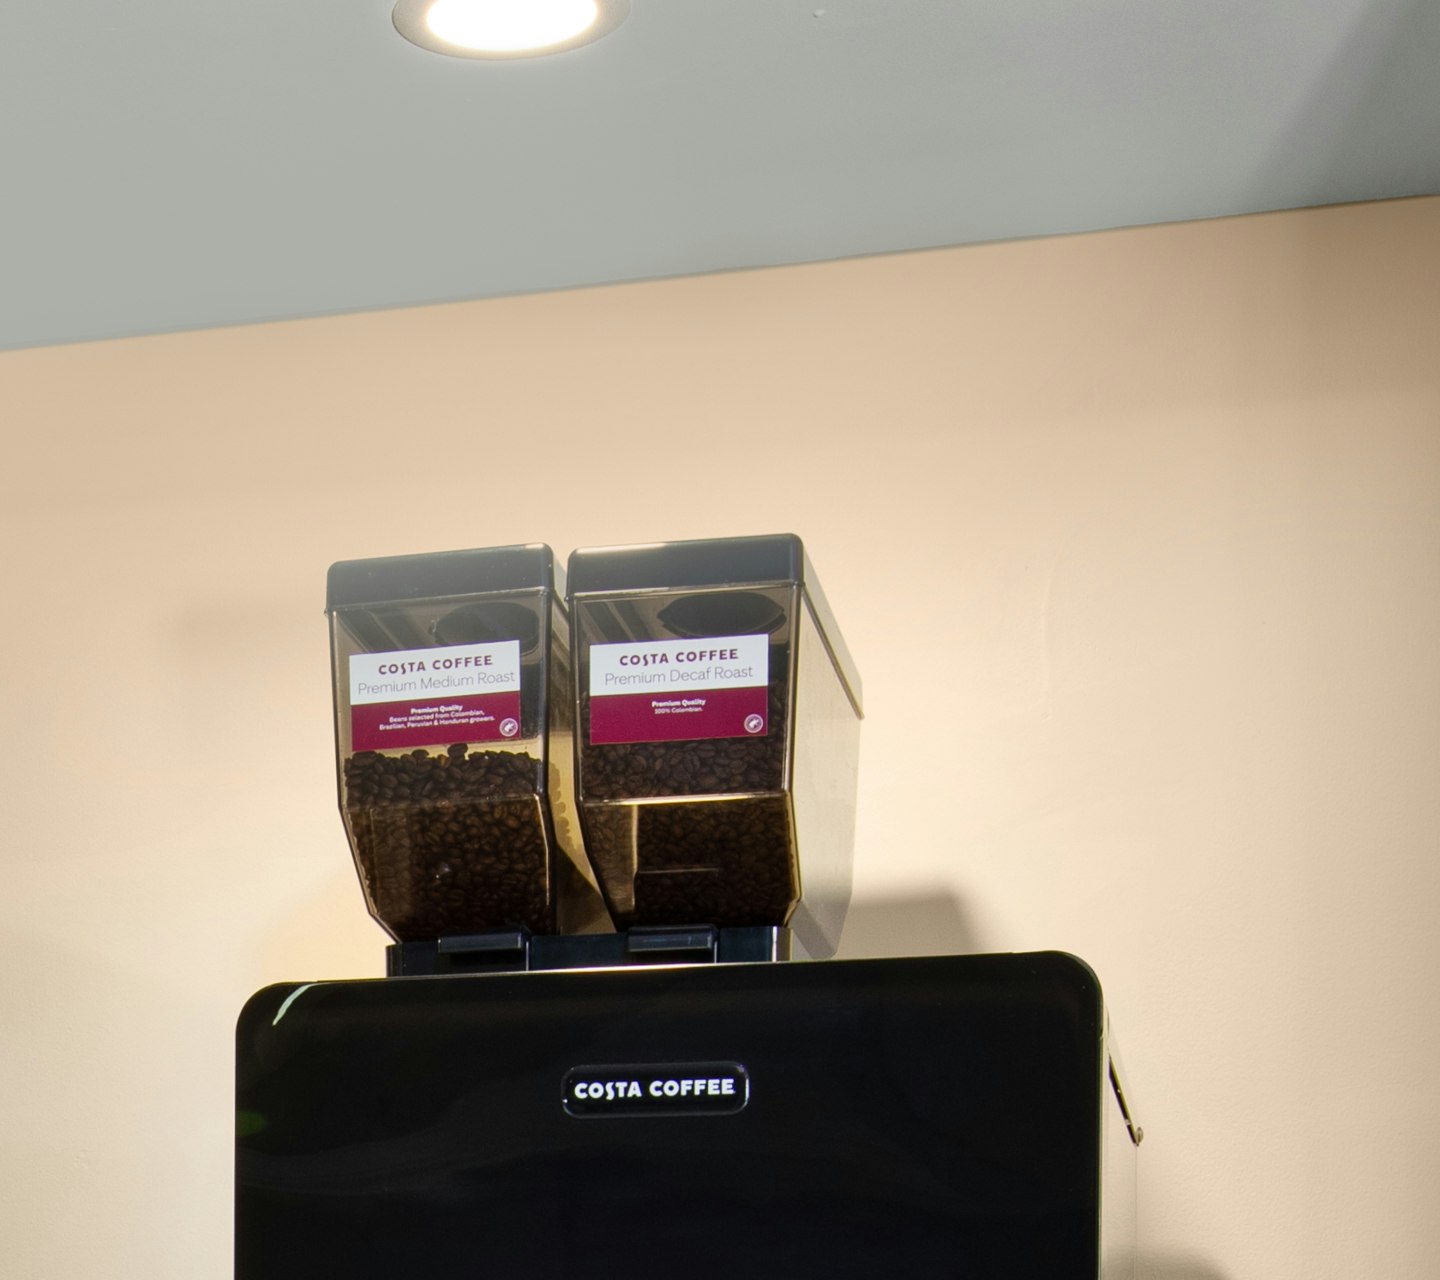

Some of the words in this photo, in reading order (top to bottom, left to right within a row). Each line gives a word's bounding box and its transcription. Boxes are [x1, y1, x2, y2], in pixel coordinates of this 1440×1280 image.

[378, 661, 426, 675] COSTA
[432, 655, 493, 670] COFFEE
[619, 653, 669, 667] COSTA
[676, 648, 739, 663] COFFEE
[358, 681, 417, 695] Premium
[420, 674, 474, 689] Medium
[478, 671, 515, 685] Roast
[604, 672, 666, 686] Premium
[670, 667, 712, 682] Decaf
[715, 666, 753, 680] Roast
[682, 699, 706, 707] Quality
[574, 1081, 642, 1100] COSTA
[649, 1079, 735, 1097] COFFEE
